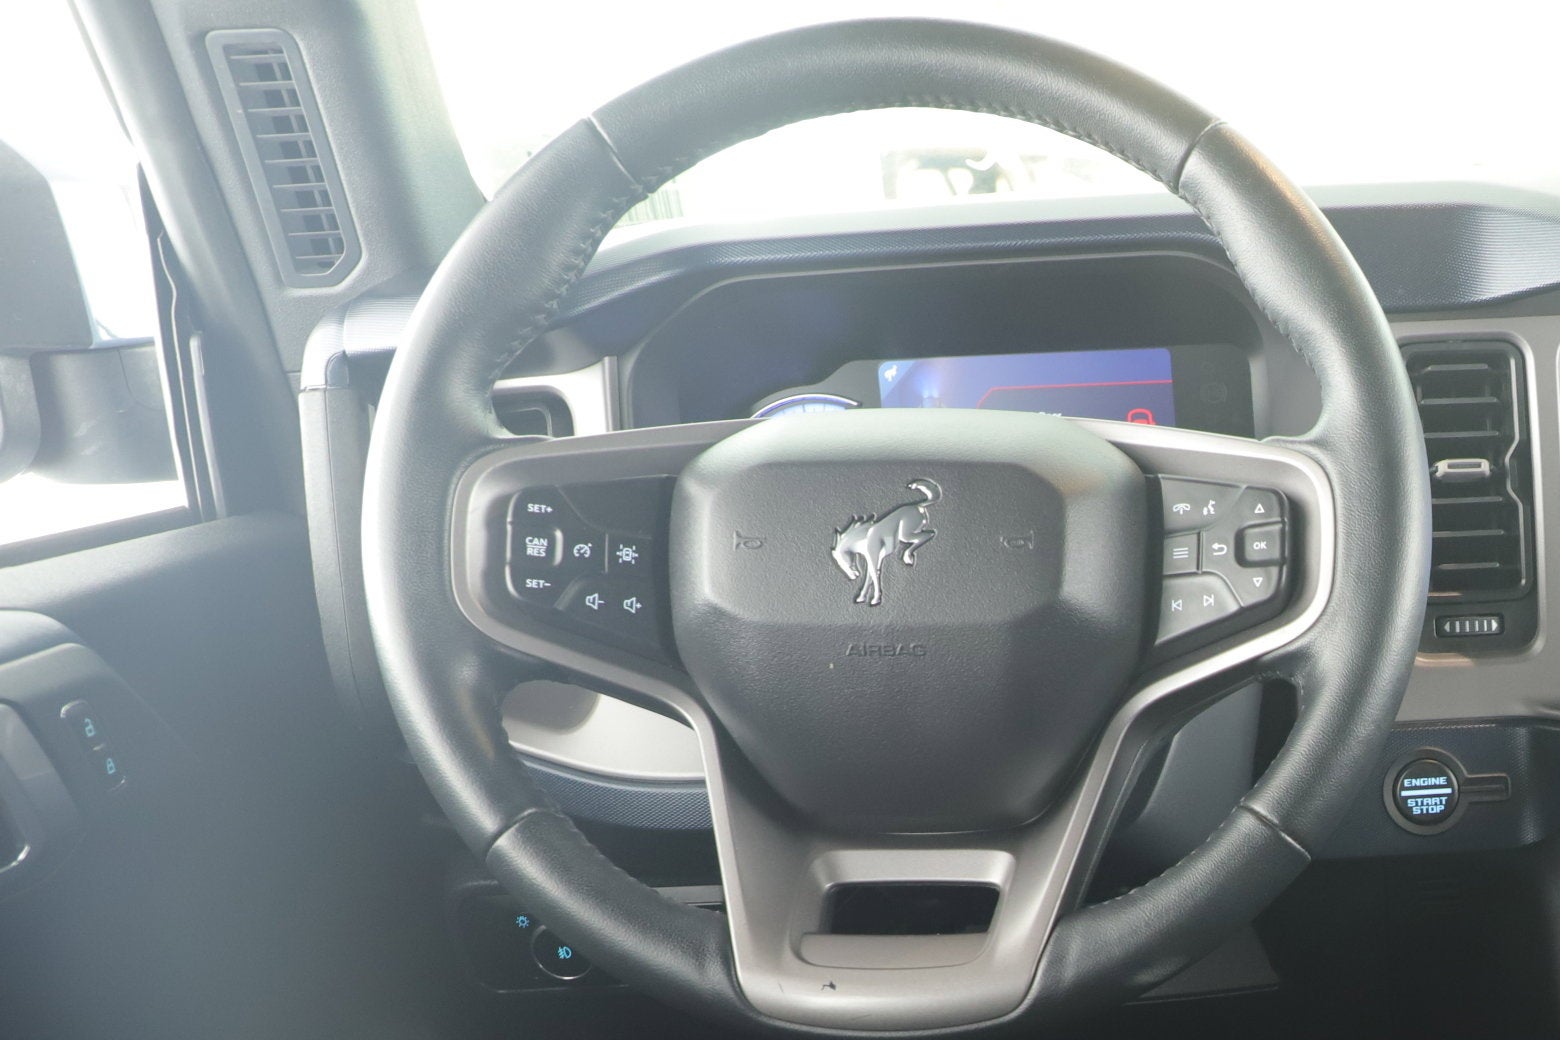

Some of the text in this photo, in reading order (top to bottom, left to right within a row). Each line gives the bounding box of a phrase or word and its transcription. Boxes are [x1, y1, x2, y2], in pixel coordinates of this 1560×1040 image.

[527, 503, 553, 513] SET+
[525, 537, 548, 546] CAN
[1253, 541, 1267, 550] OK
[526, 548, 546, 557] RES
[845, 643, 928, 657] AIRBAG
[1403, 776, 1447, 787] ENGINE
[1407, 797, 1448, 807] START
[1412, 805, 1445, 815] STOP
